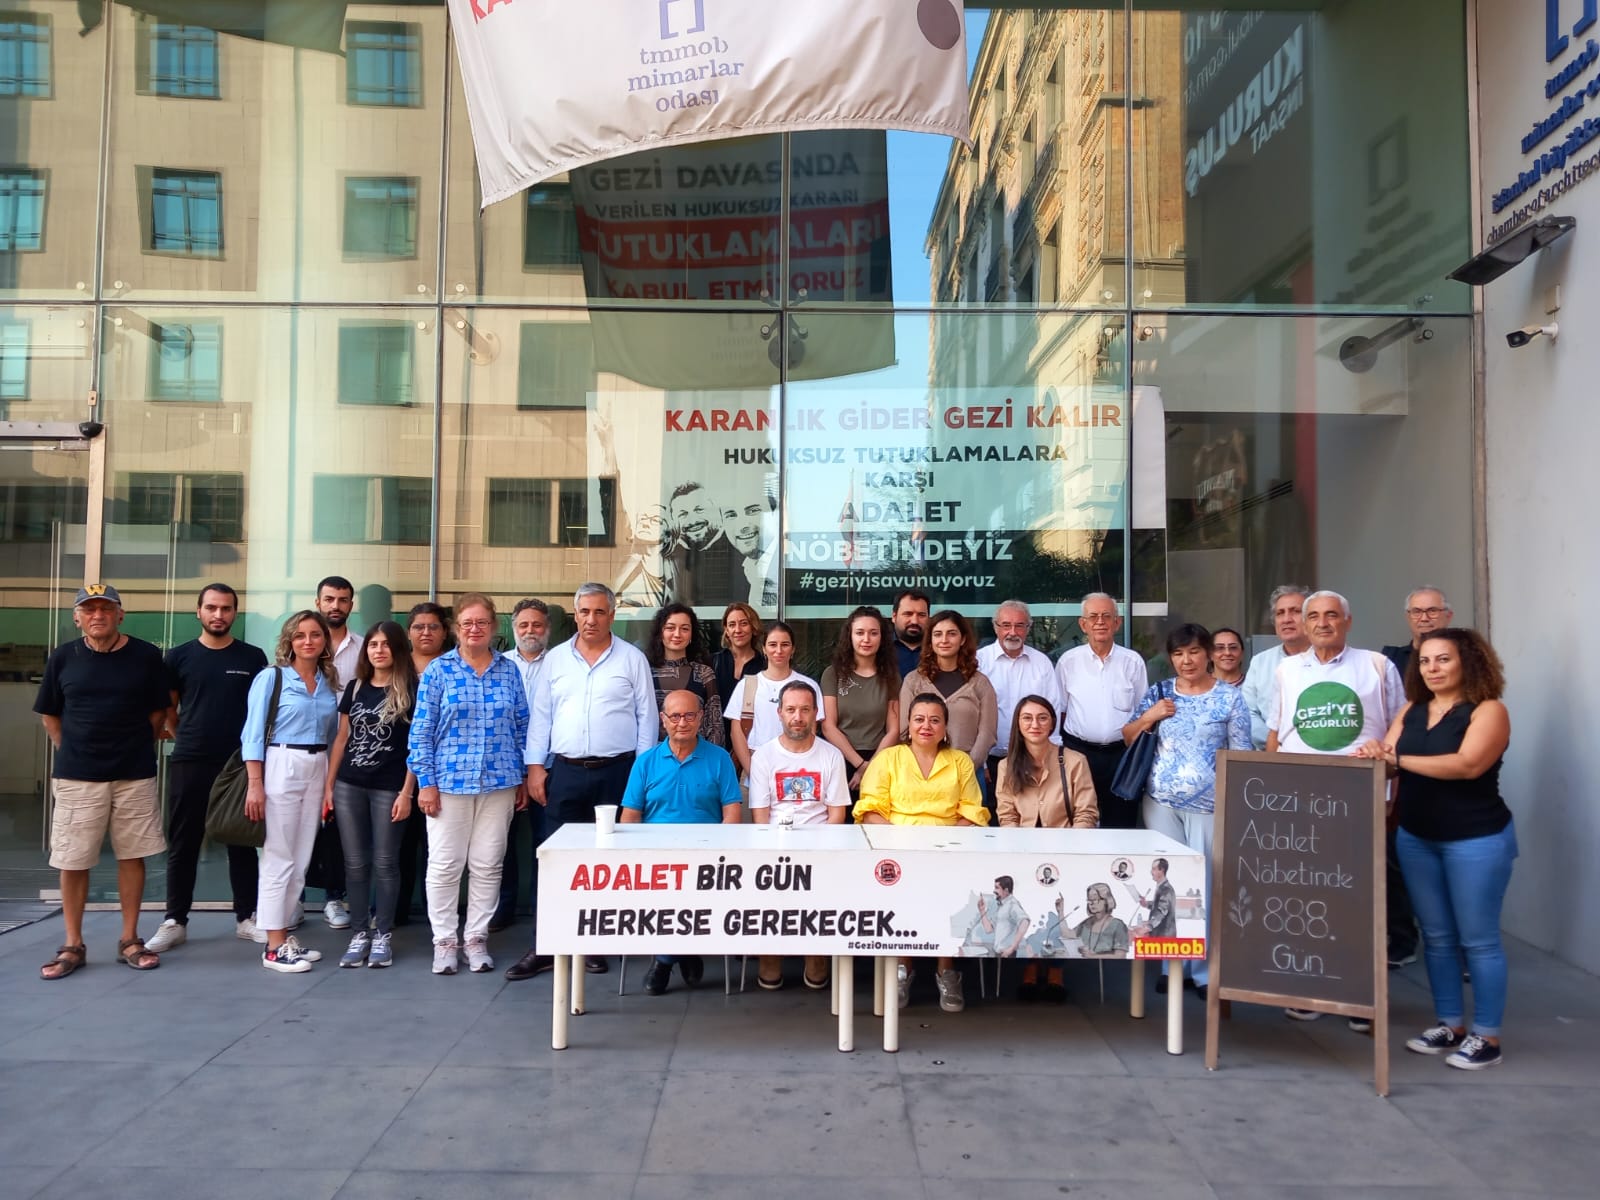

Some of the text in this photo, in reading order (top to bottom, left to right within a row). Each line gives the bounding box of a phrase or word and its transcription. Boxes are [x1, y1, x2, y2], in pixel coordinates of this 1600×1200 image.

[640, 36, 729, 65] tmmob
[627, 59, 745, 92] mimarlar
[655, 89, 719, 113] odası
[590, 152, 860, 192] GEZİ DAVASNDA
[595, 200, 677, 219] VERİLEN
[1487, 202, 1532, 246] chamber
[591, 213, 881, 262] UTUKLAMALARI
[709, 267, 865, 301] ETMİORUZ
[838, 401, 931, 431] GİDER
[943, 398, 1013, 429] GEZİ
[1026, 404, 1122, 428] KALIR
[854, 445, 1069, 464] TUTUKLAMALARA
[865, 471, 935, 494] KARŞI
[837, 500, 962, 524] ADALET
[787, 532, 1013, 562] NÖBETİNDEYİZ
[799, 571, 996, 592] #geziyisavunuyoruz
[1243, 777, 1348, 819] Gezi için
[1239, 819, 1320, 854] Adalet
[570, 855, 812, 891] ADALET BİR GÜN
[1238, 855, 1353, 889] Nöbetinde
[577, 908, 919, 938] HERKESE GEREKECEK...
[1263, 896, 1337, 942] 888.
[848, 941, 940, 951] #GeziOnurumuzdur
[1135, 938, 1204, 955] tmmob
[1272, 943, 1325, 974] Gün
